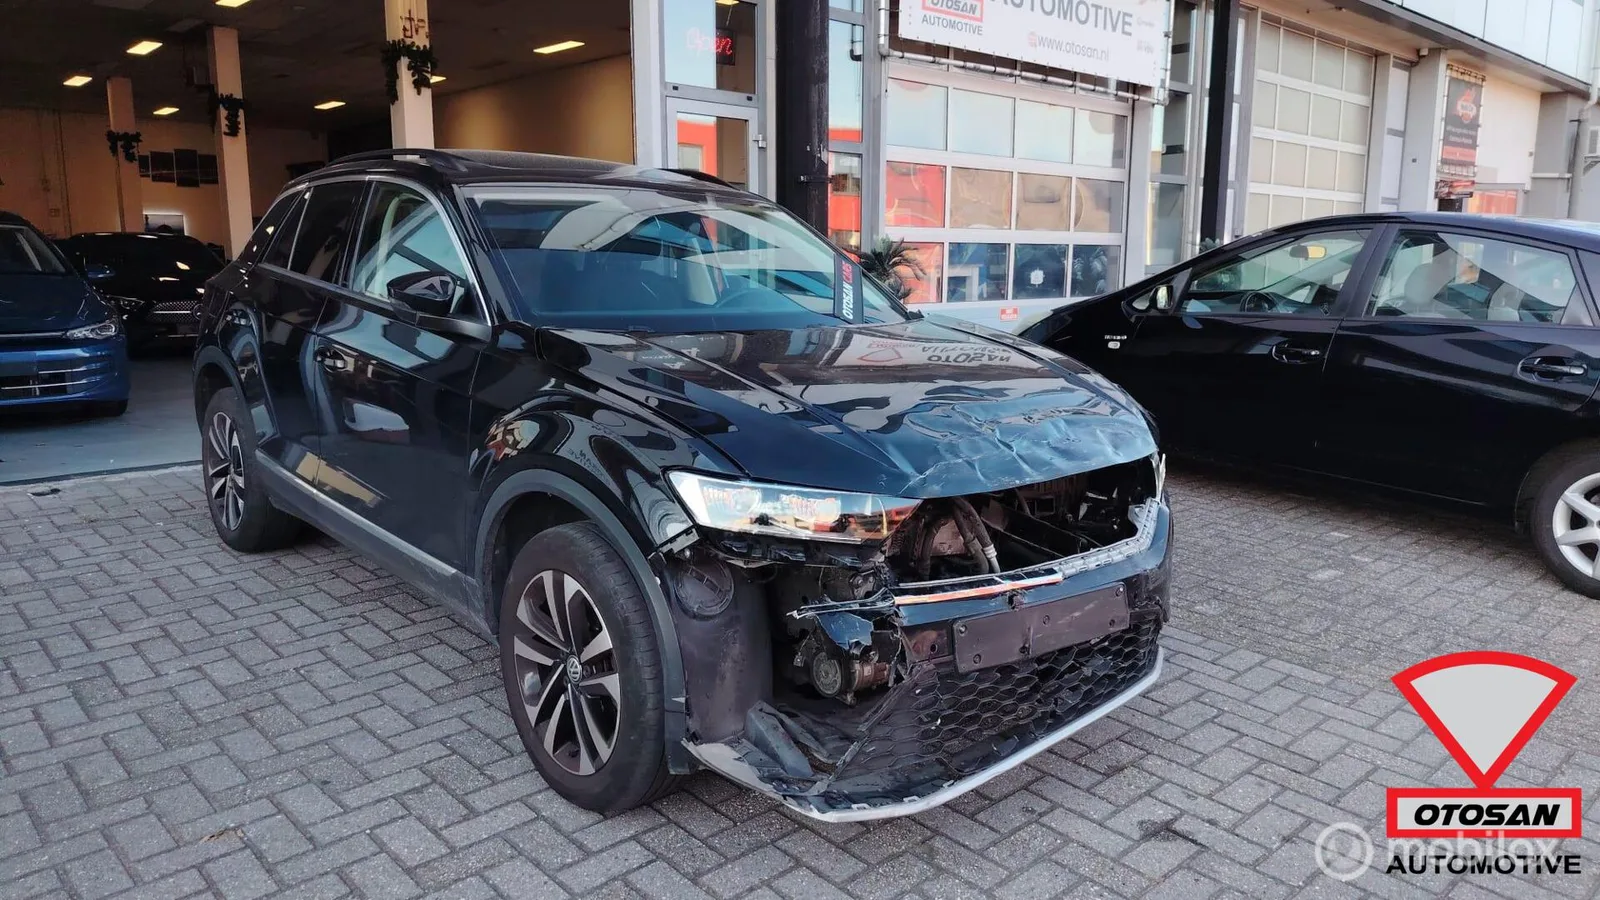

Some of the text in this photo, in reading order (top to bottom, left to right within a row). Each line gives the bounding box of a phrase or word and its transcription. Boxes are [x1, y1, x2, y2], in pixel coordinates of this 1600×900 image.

[921, 14, 983, 36] AUTOMOTIVE
[1037, 36, 1110, 62] www.otosan.nl
[842, 281, 854, 320] OTOSAN
